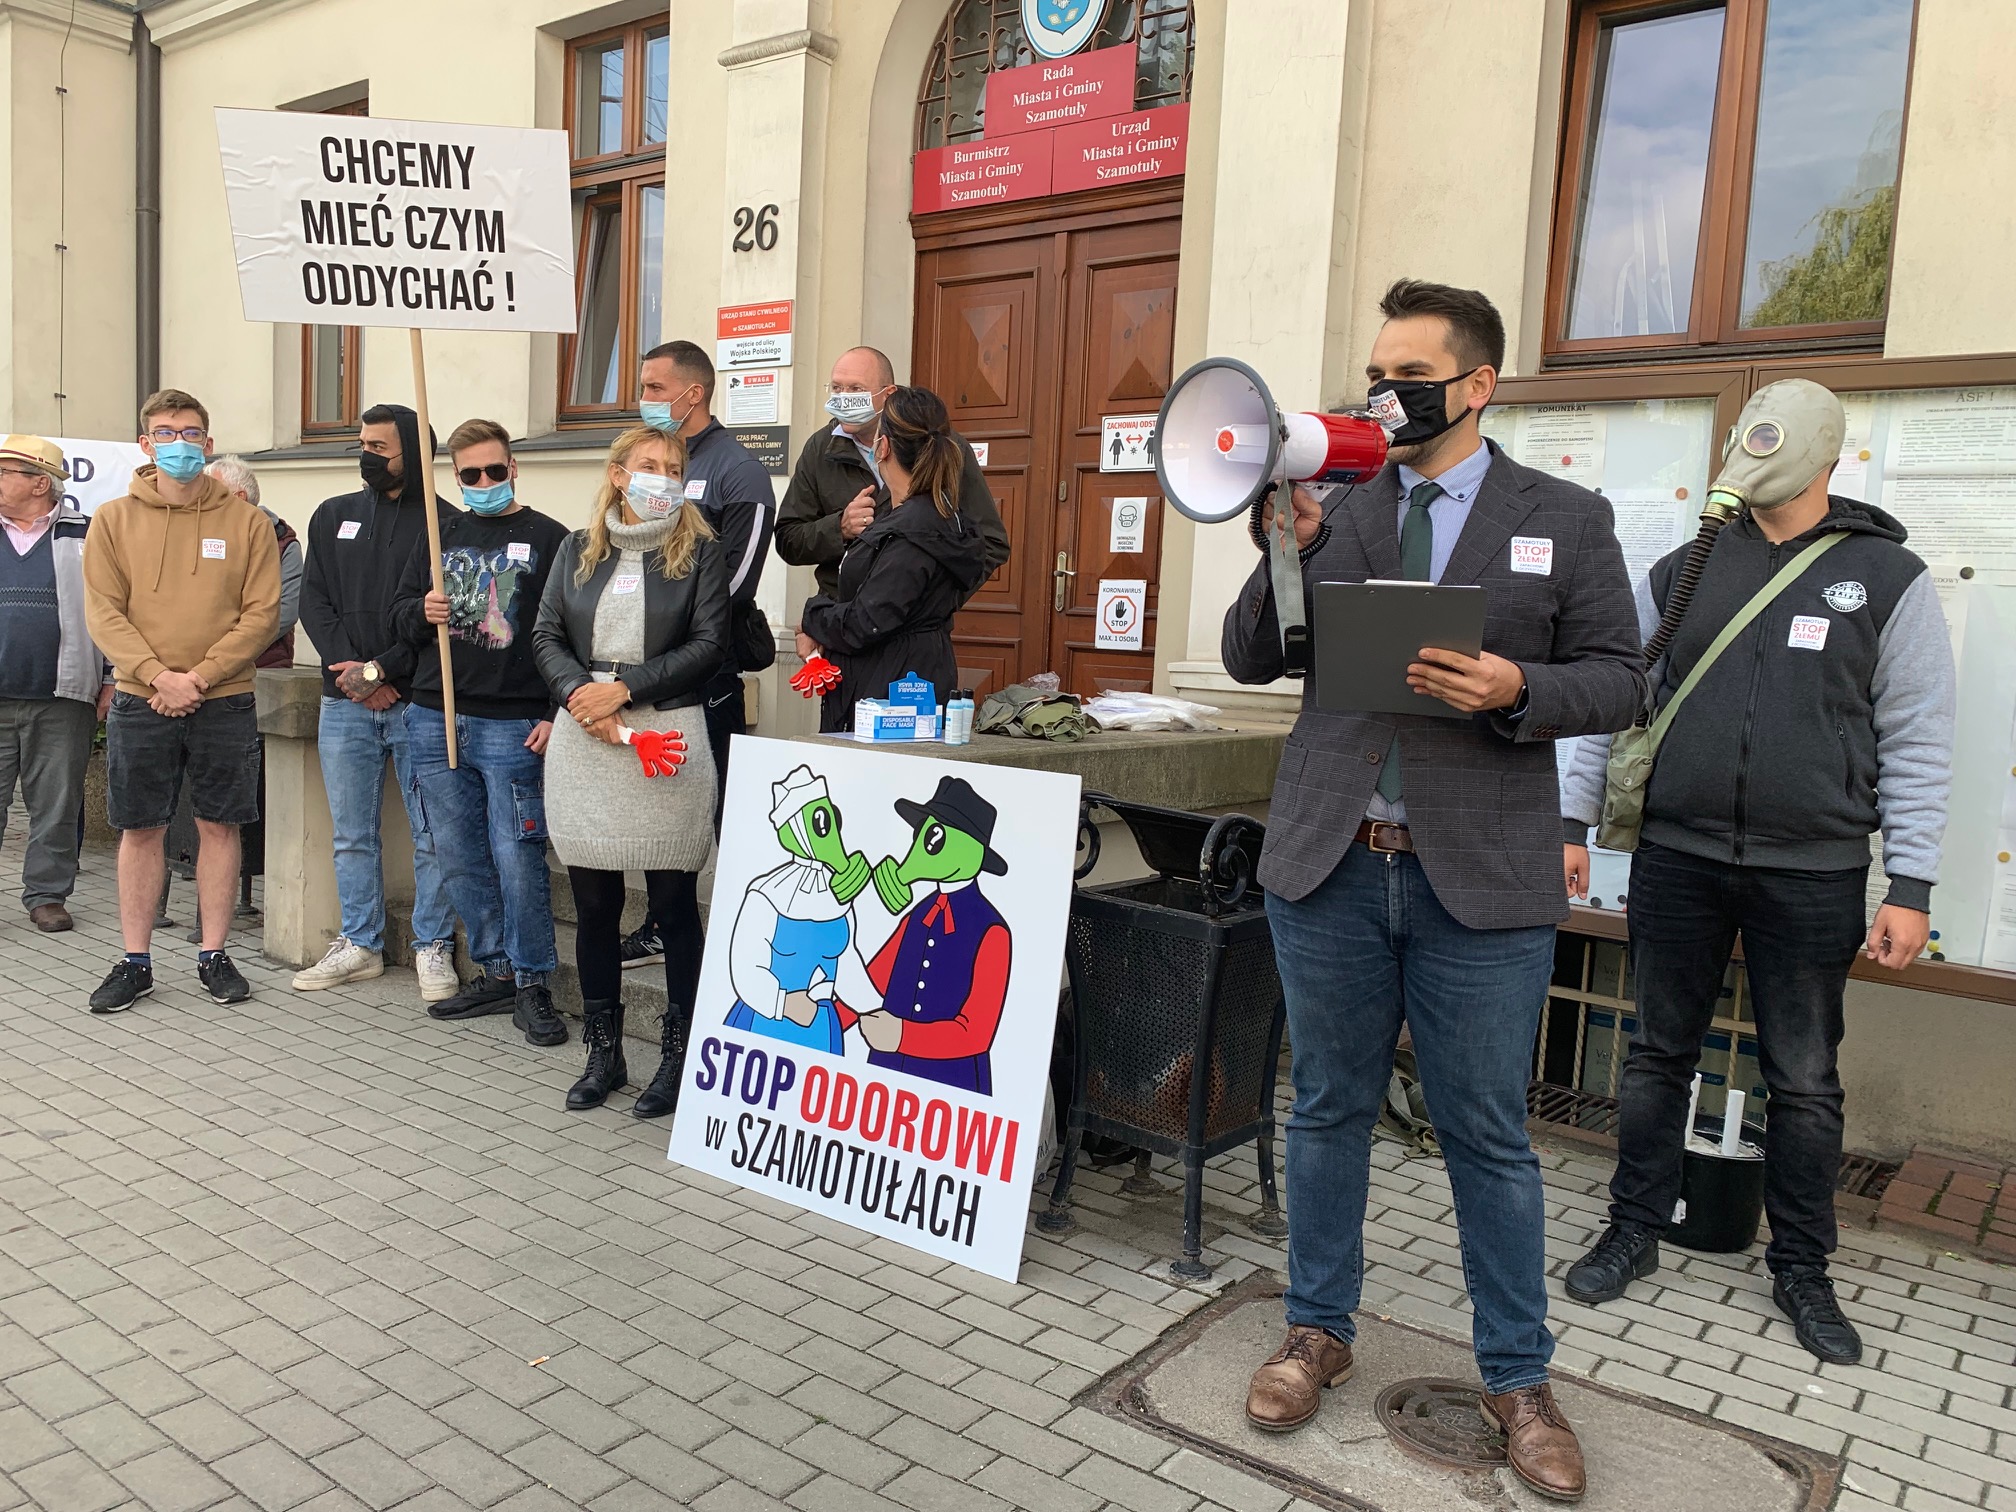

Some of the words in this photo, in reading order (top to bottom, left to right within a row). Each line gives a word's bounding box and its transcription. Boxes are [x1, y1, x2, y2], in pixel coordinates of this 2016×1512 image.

[1043, 64, 1074, 81] Rada
[1012, 90, 1052, 107] Miasta
[1055, 86, 1060, 99] i
[1062, 80, 1104, 97] Gminy
[1025, 102, 1088, 124] Szamotuły
[1111, 117, 1150, 136] Urząd
[954, 145, 1010, 164] Burmistrz
[1082, 145, 1124, 162] Miasta
[1127, 141, 1132, 154] i
[1135, 135, 1180, 153] Gminy
[320, 136, 475, 190] CHCEMY
[1096, 158, 1162, 180] Szamotuły
[939, 169, 975, 186] Miasta
[978, 166, 983, 179] i
[985, 162, 1024, 178] Gminy
[951, 182, 1009, 202] Szamotuły
[300, 193, 394, 248] MIEĆ
[404, 205, 506, 253] CZYM
[733, 204, 779, 253] 26
[302, 260, 495, 312] ODDYCHAĆ
[505, 271, 516, 312] !
[721, 312, 739, 320] URZĄD
[739, 309, 757, 318] STANU
[757, 306, 788, 316] CYWILNEGO
[737, 322, 776, 332] SZAMOTUŁACH
[730, 349, 751, 358] Wojska
[752, 347, 781, 355] Polskiego
[736, 340, 754, 349] wejście
[763, 339, 775, 347] ulicy
[1955, 392, 1986, 403] ASF
[1537, 405, 1587, 413] KOMUNIKAT
[1107, 421, 1139, 430] ZACHOWAJ
[1140, 420, 1157, 428] ODST
[648, 497, 670, 508] STOP
[1513, 544, 1551, 556] STOP
[1517, 555, 1546, 564] ZŁEMU
[1793, 623, 1826, 634] STOP
[1794, 632, 1820, 640] ZŁEMU
[695, 1036, 797, 1111] STOP
[800, 1065, 1020, 1184] ODOROWI
[731, 1112, 982, 1247] SZAMOTUŁACH
